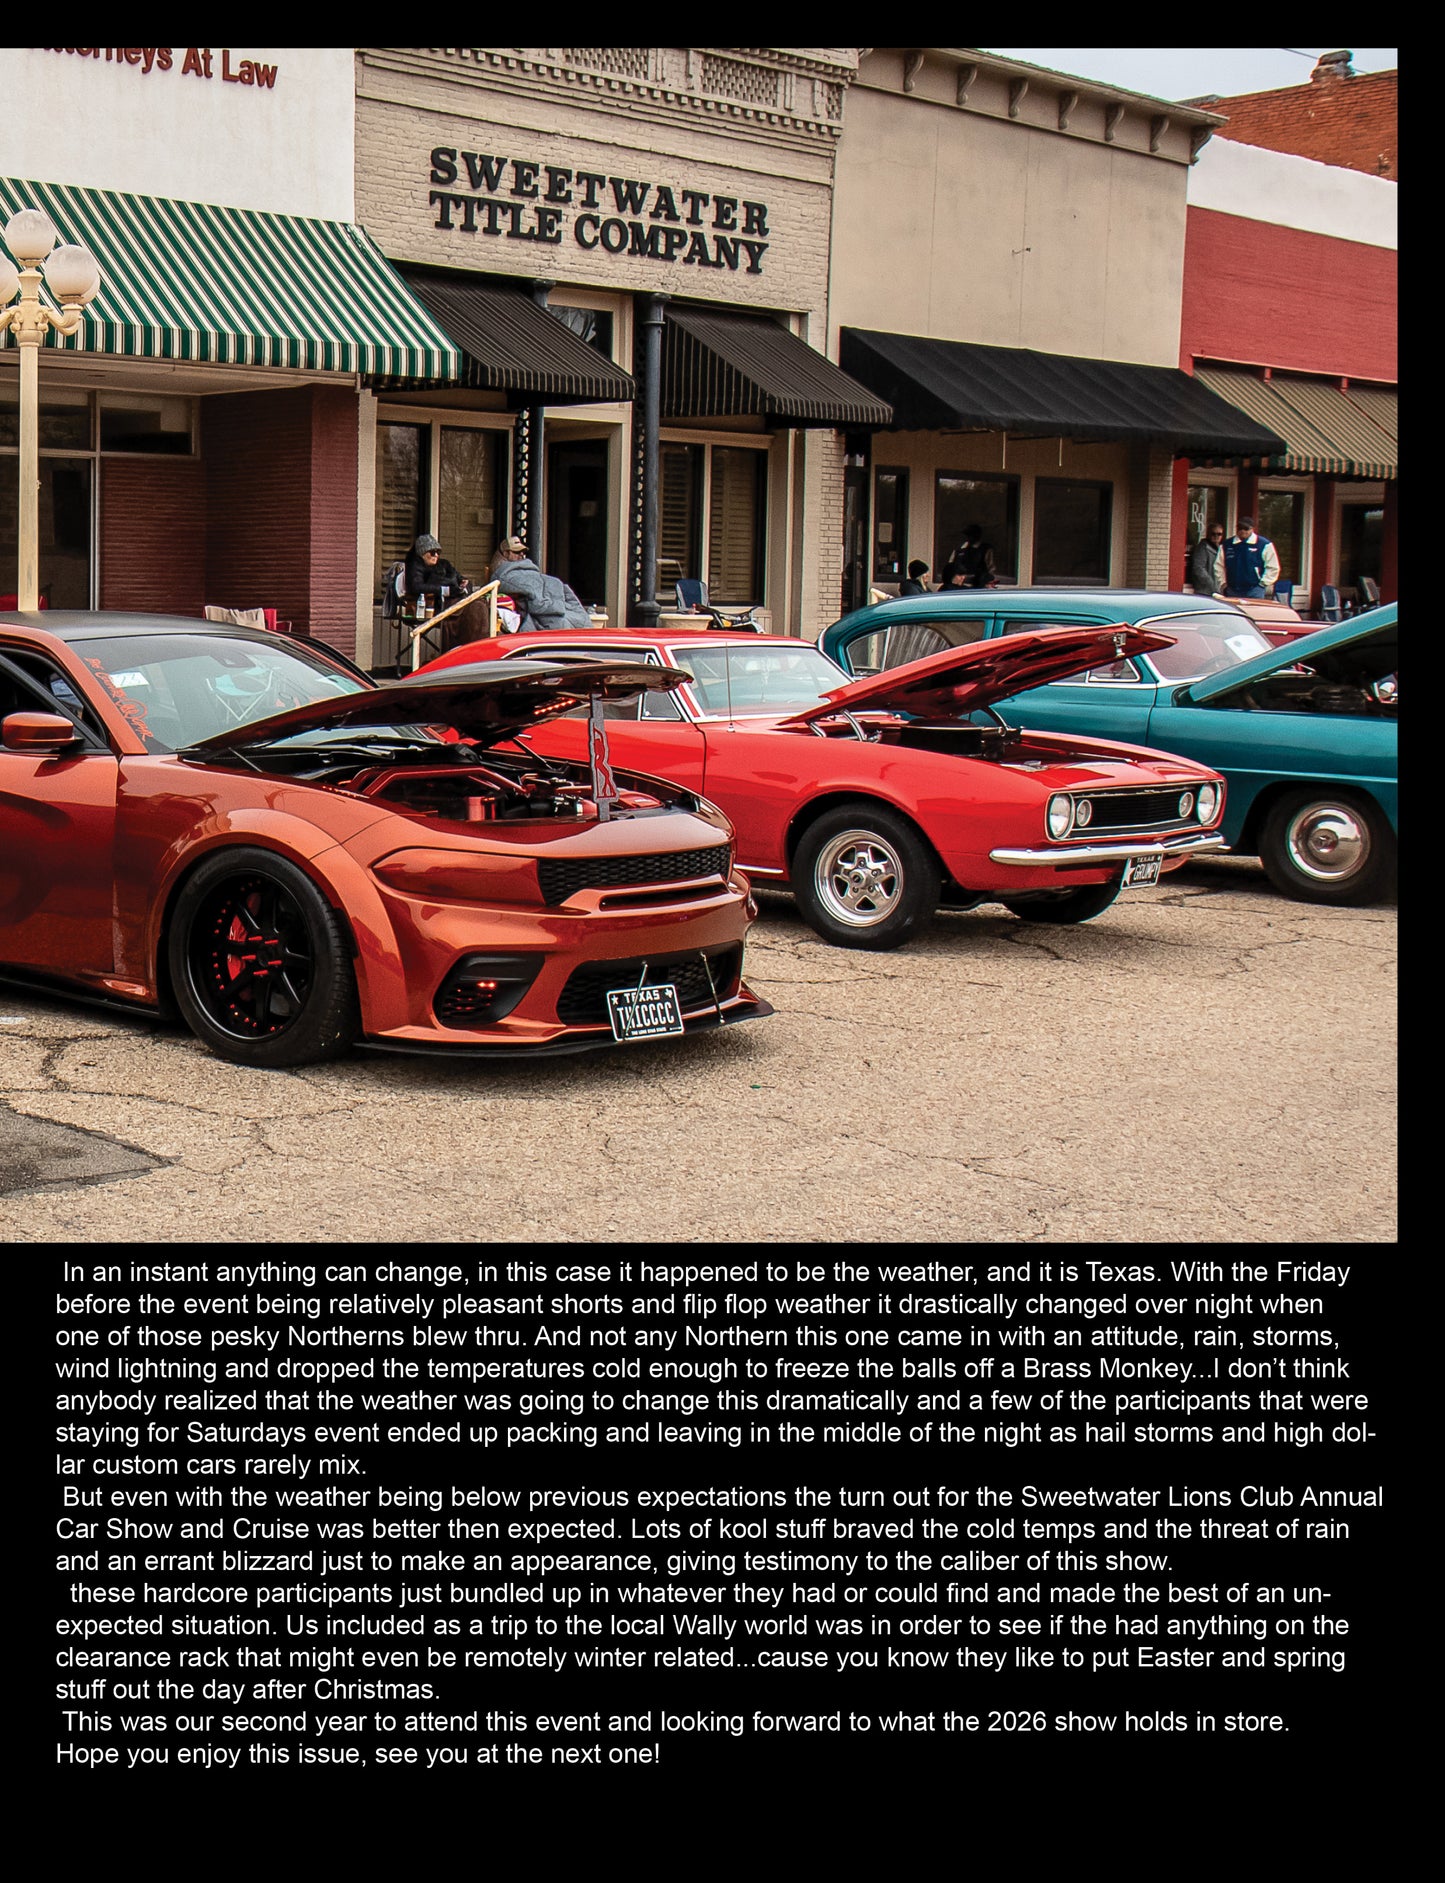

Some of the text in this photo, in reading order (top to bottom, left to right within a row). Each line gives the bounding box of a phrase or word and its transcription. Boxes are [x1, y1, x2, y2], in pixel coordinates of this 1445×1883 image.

[182, 48, 213, 78] At
[222, 50, 278, 88] Law
[430, 146, 770, 237] SWEETWATER
[429, 190, 770, 274] TITLE COMPANY
[623, 990, 660, 1004] TEXAS
